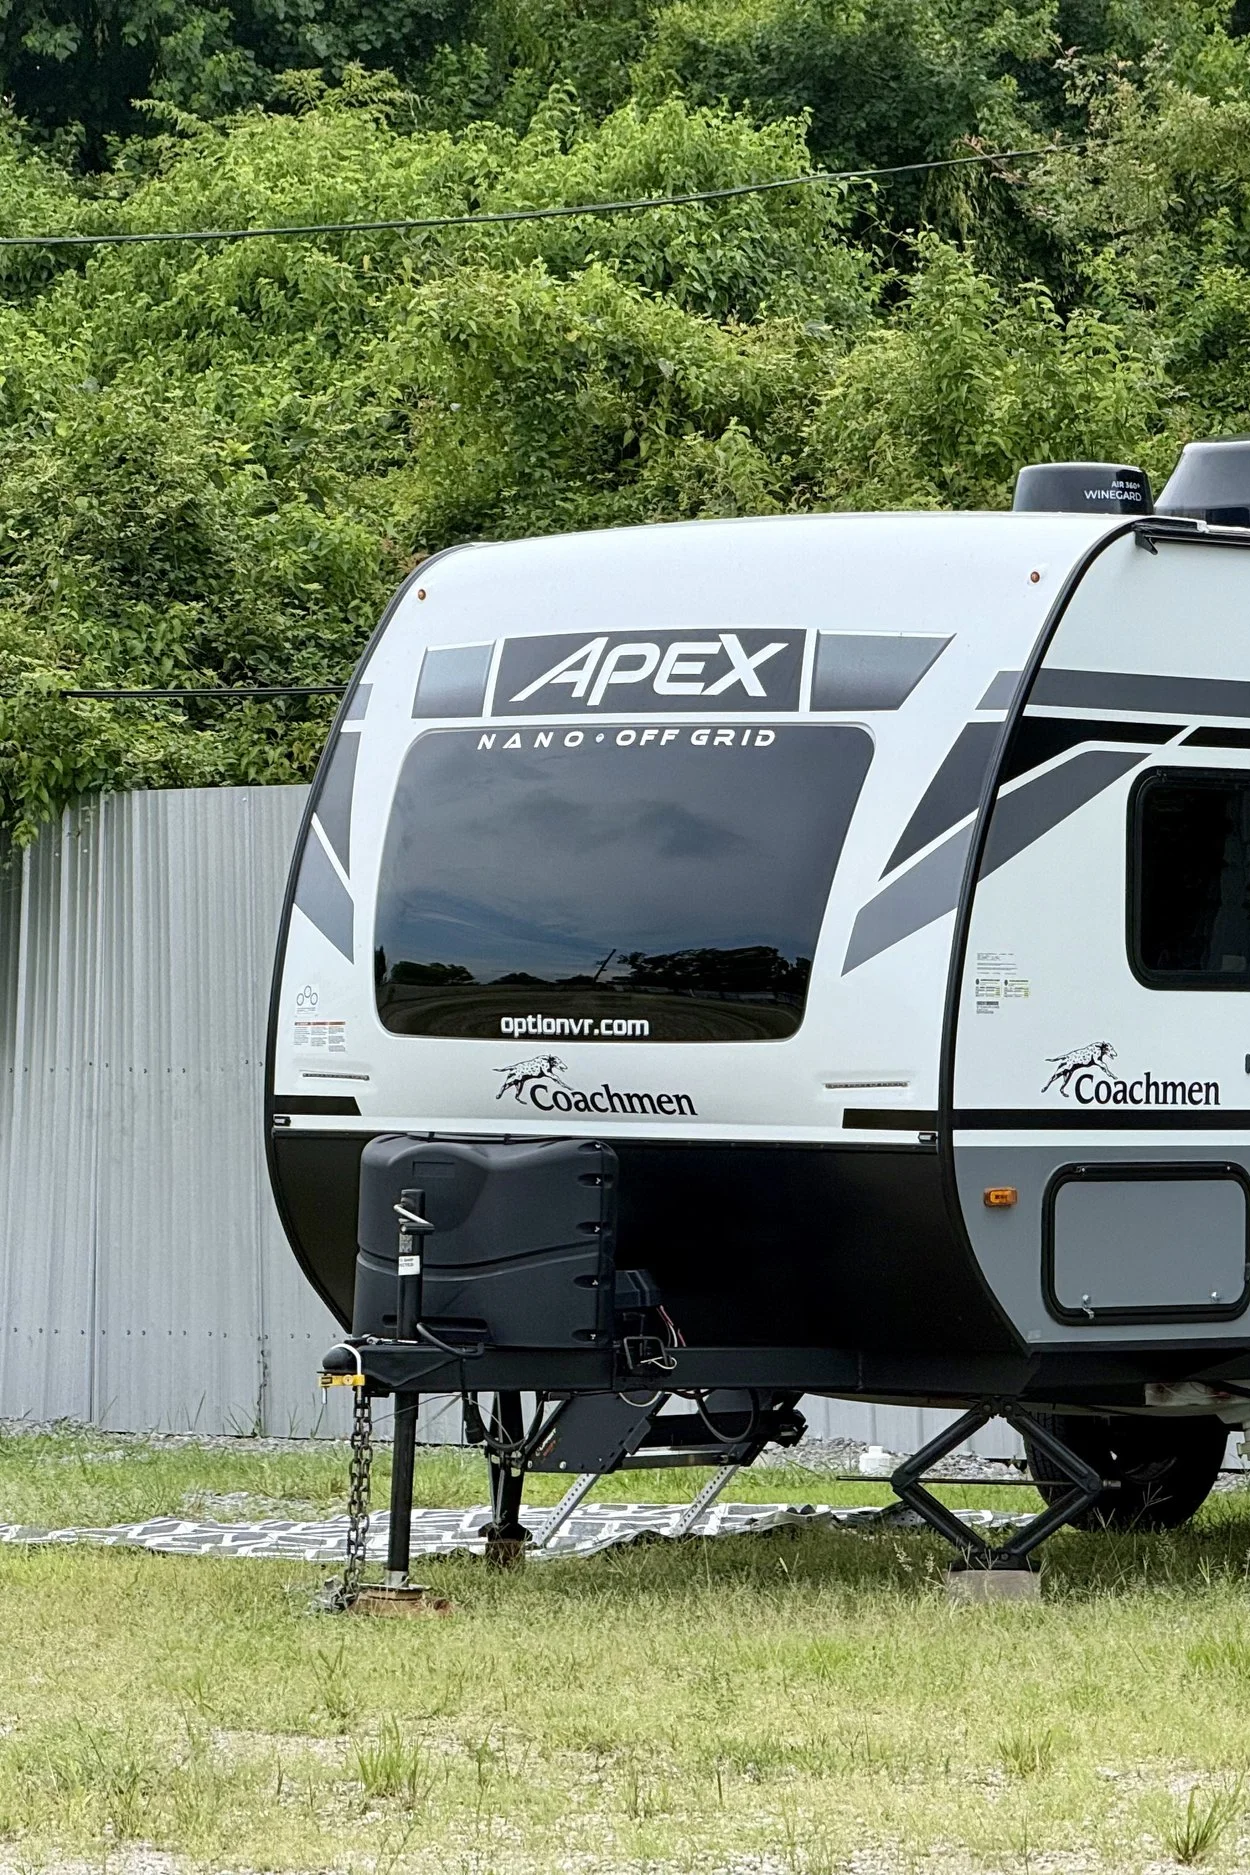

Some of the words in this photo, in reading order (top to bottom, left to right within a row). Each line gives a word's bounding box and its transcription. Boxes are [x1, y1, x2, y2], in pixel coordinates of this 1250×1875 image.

[1084, 489, 1142, 502] WINEGARD
[1111, 480, 1125, 489] AIR
[509, 633, 789, 706] APEX
[477, 730, 585, 750] NANO
[615, 729, 680, 747] OFF
[690, 728, 777, 748] GRID
[500, 1014, 650, 1038] optionvr.com
[529, 1083, 699, 1116] Coachmen
[1074, 1071, 1221, 1106] Coachmen
